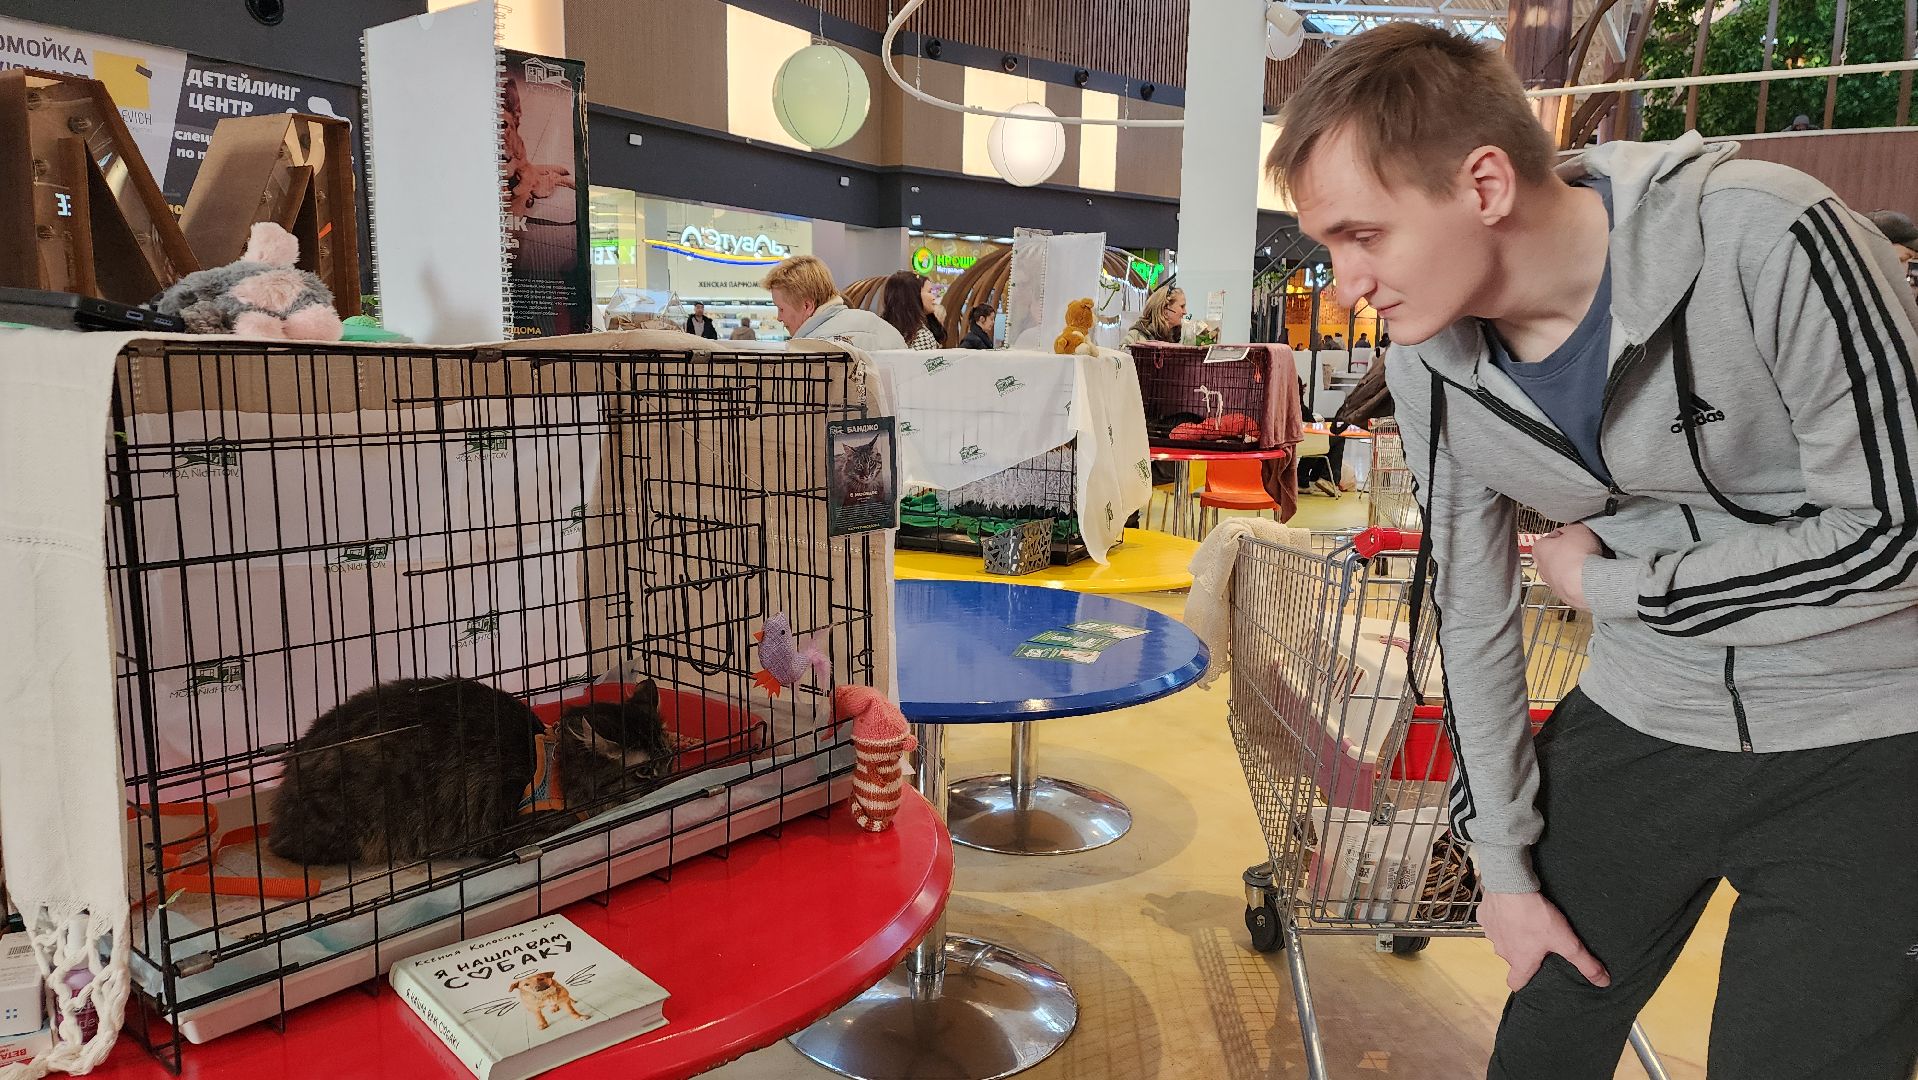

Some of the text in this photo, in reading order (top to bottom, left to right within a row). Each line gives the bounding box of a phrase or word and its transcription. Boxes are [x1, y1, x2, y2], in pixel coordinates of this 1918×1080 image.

[186, 68, 301, 102] ДЕТЕЙЛИНГ
[188, 92, 254, 117] ЦЕНТР
[121, 109, 153, 126] EVICH
[174, 130, 213, 146] спец
[176, 147, 195, 159] по
[698, 280, 762, 288] ЖЕНСКАЯ ПАРФЮМ
[846, 423, 880, 434] БАНДЖО
[1670, 409, 1726, 434] adas
[434, 933, 568, 980] Я НАШЛА ВАМ
